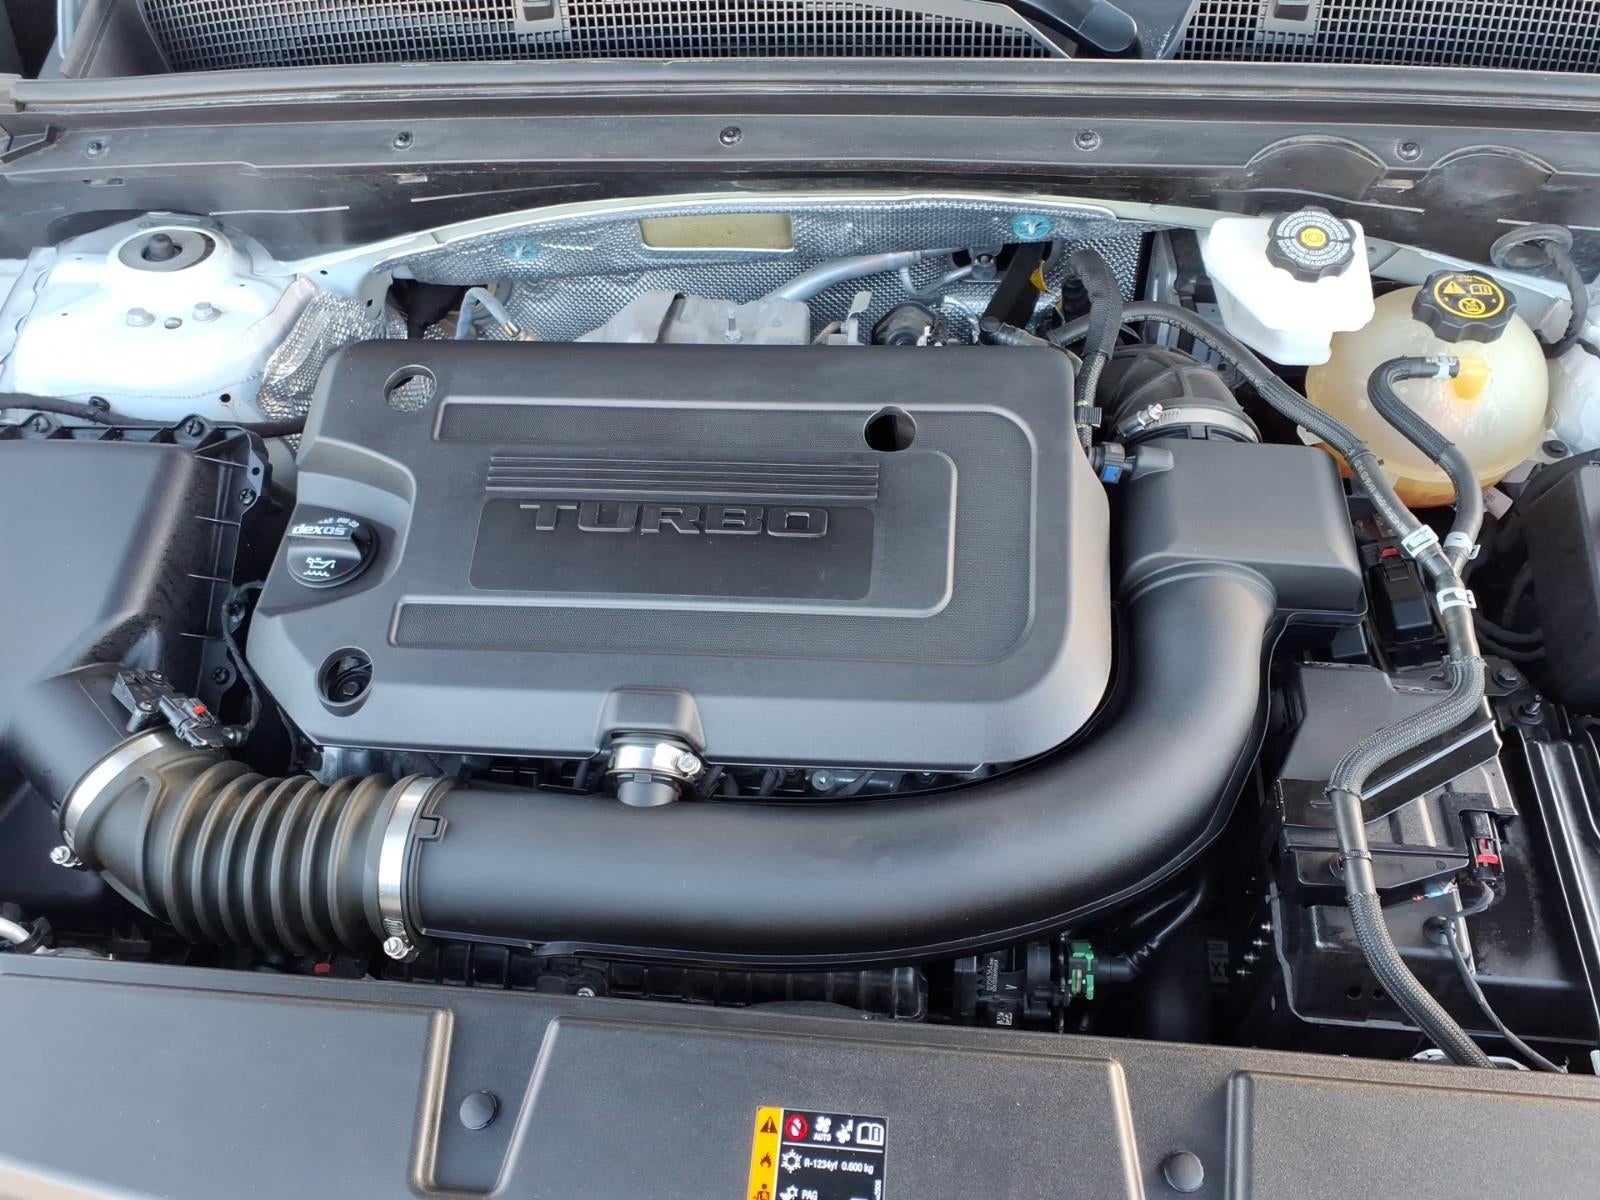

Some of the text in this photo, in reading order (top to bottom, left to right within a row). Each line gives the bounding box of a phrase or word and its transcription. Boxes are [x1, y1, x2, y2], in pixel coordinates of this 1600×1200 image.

[519, 501, 829, 538] TURBO
[291, 523, 347, 536] dexos
[813, 1132, 832, 1141] AUTO
[804, 1158, 874, 1175] R-1234yf 0.600 kg
